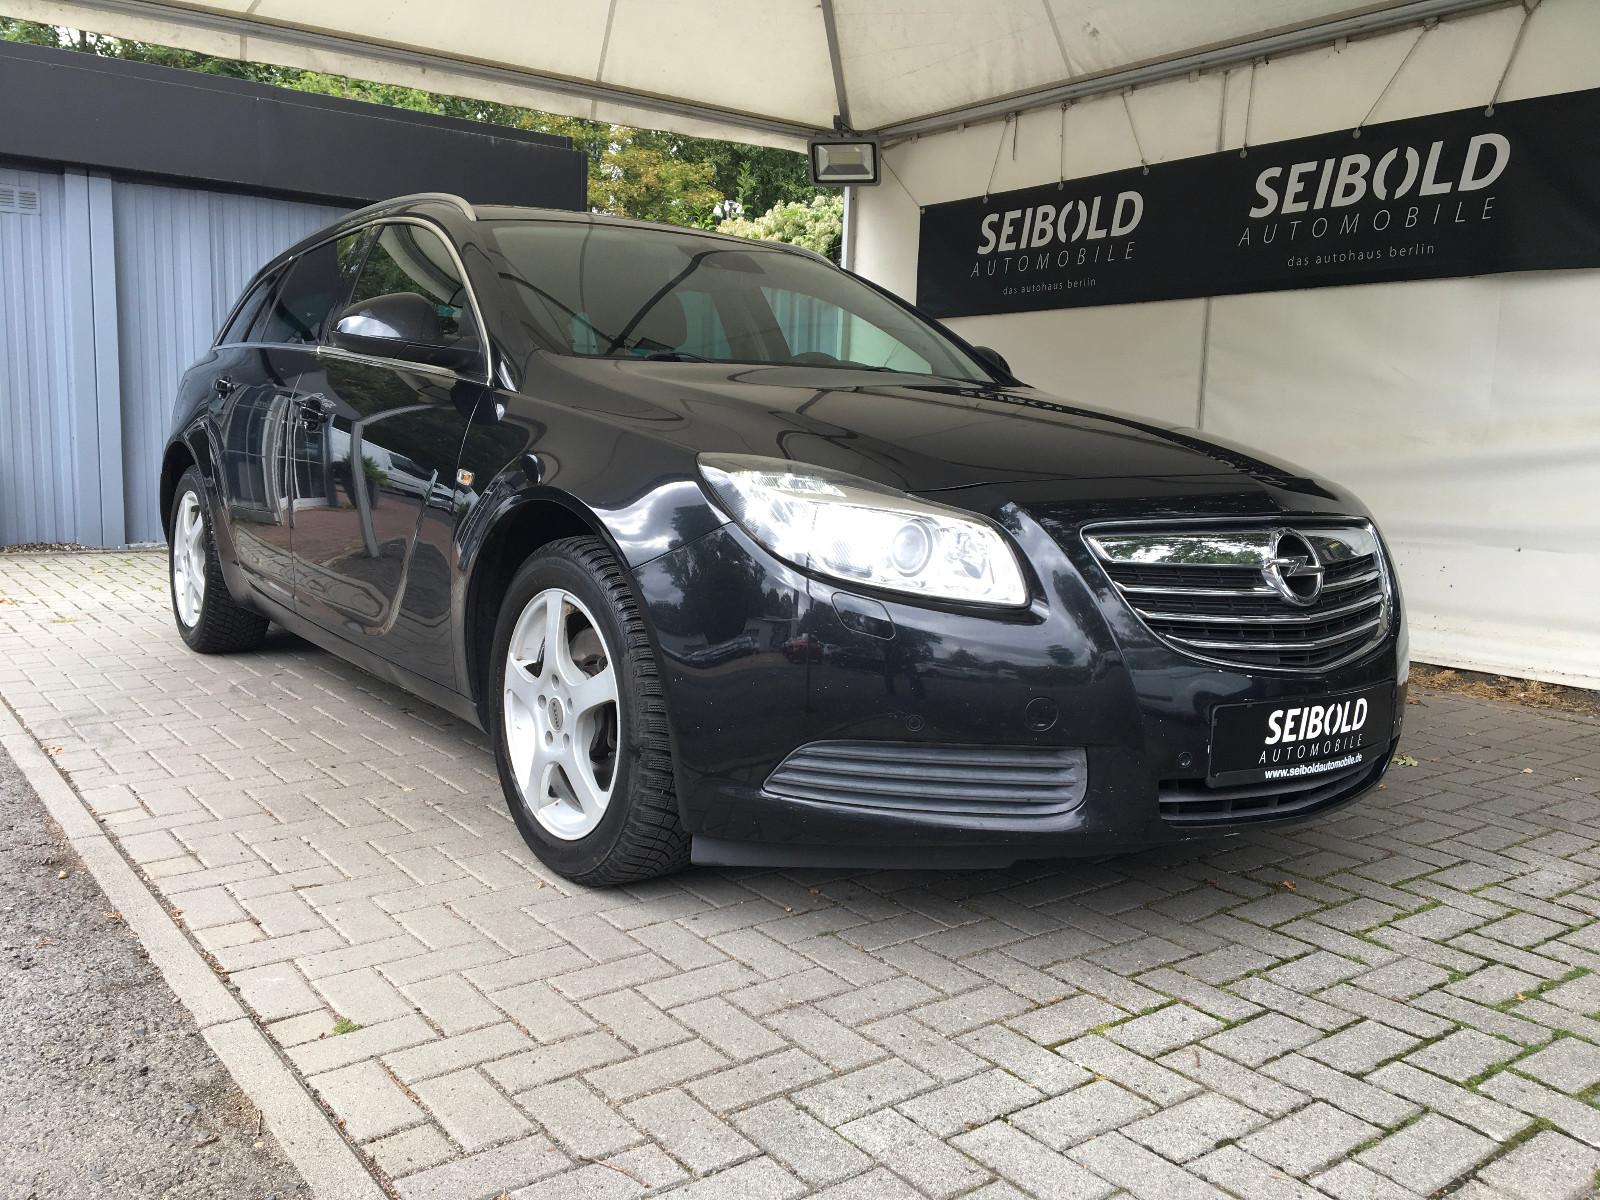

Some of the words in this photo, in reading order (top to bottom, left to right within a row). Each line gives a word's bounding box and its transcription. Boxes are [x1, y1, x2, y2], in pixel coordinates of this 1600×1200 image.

[1249, 133, 1511, 218] SEIBOLD
[977, 191, 1144, 255] SEIBOLD
[1239, 196, 1496, 247] AUTOMOBILE
[971, 241, 1136, 278] AUTOMOBILE
[1287, 254, 1309, 267] das
[1315, 249, 1382, 265] autohaus
[1389, 243, 1435, 258] berlin
[1002, 285, 1018, 296] das
[1020, 279, 1063, 294] autohaus
[1067, 278, 1096, 289] berlin
[1264, 698, 1368, 745] SEIBOLD
[1259, 733, 1363, 764] AUTOMOBILE
[1264, 752, 1363, 779] www.seiboldautomobile.de
